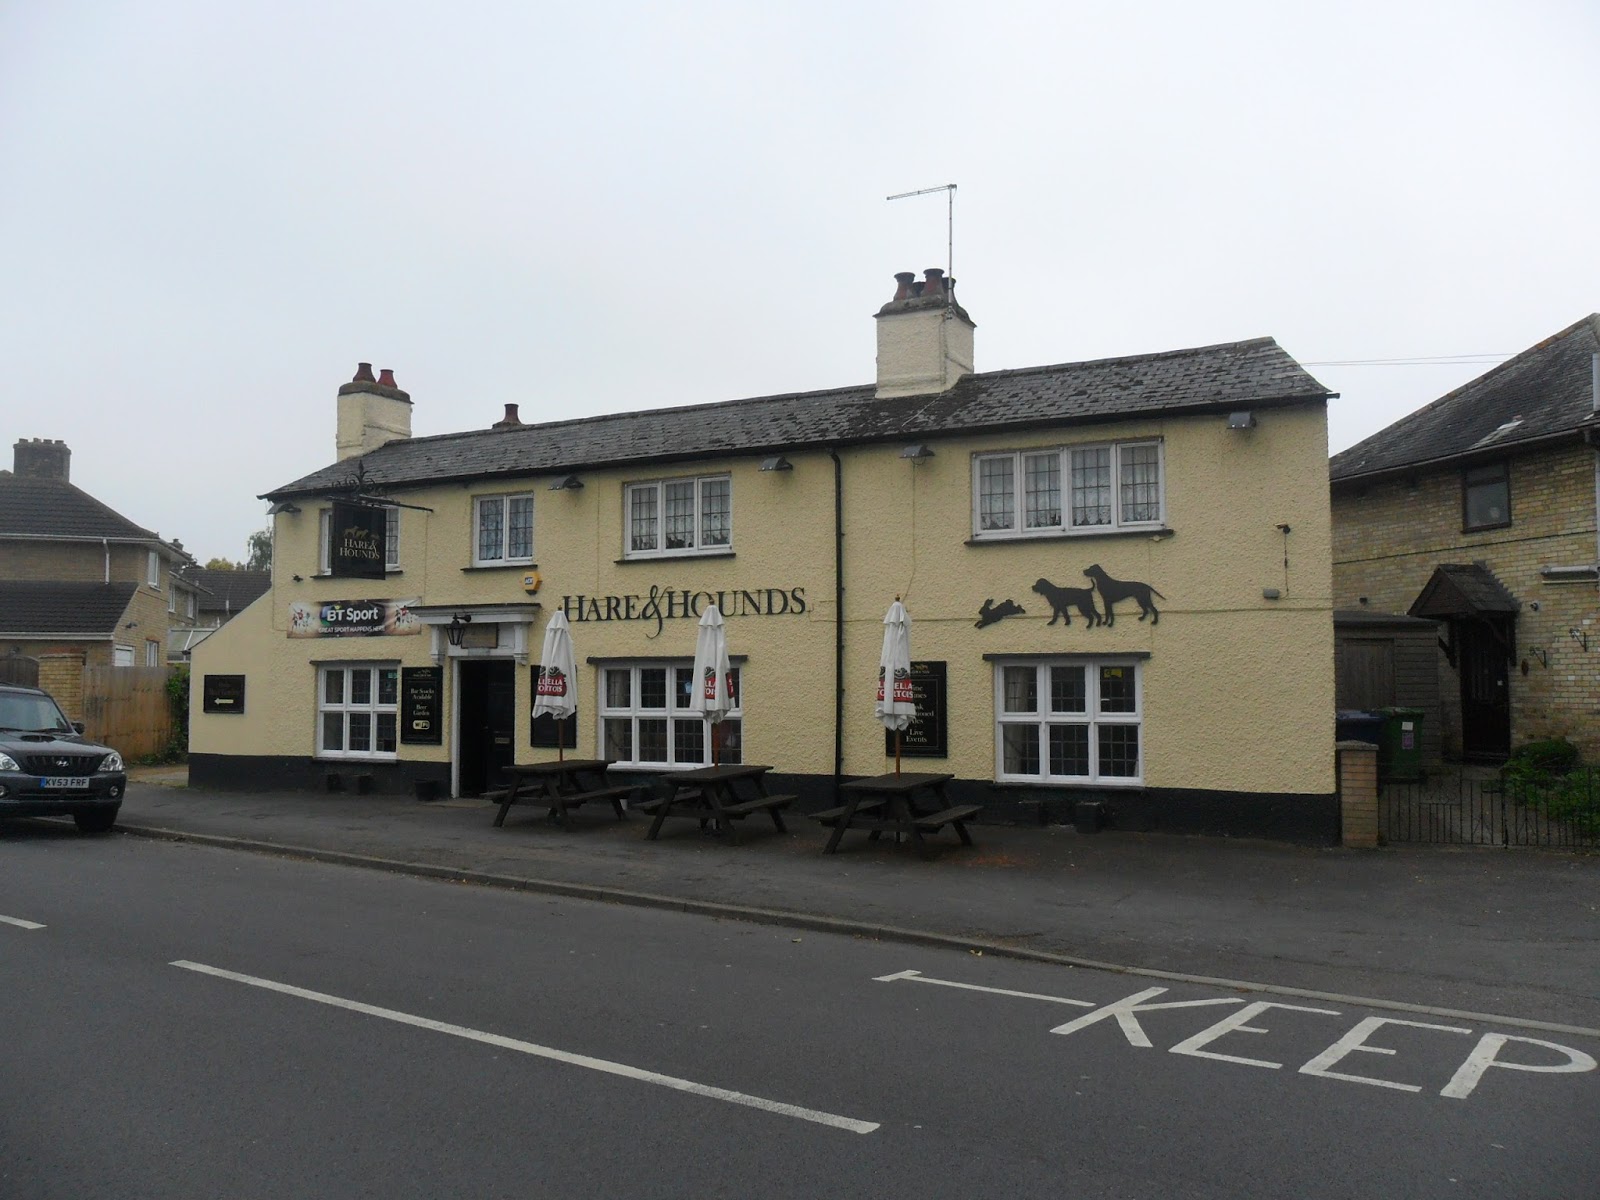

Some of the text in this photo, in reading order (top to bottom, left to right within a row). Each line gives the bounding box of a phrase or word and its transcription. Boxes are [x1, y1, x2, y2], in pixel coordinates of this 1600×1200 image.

[340, 547, 380, 560] HOUNDS
[327, 607, 379, 623] BT Sport
[905, 735, 928, 743] Events
[45, 778, 87, 787] KV53 FRF
[1050, 987, 1597, 1099] KEEP
